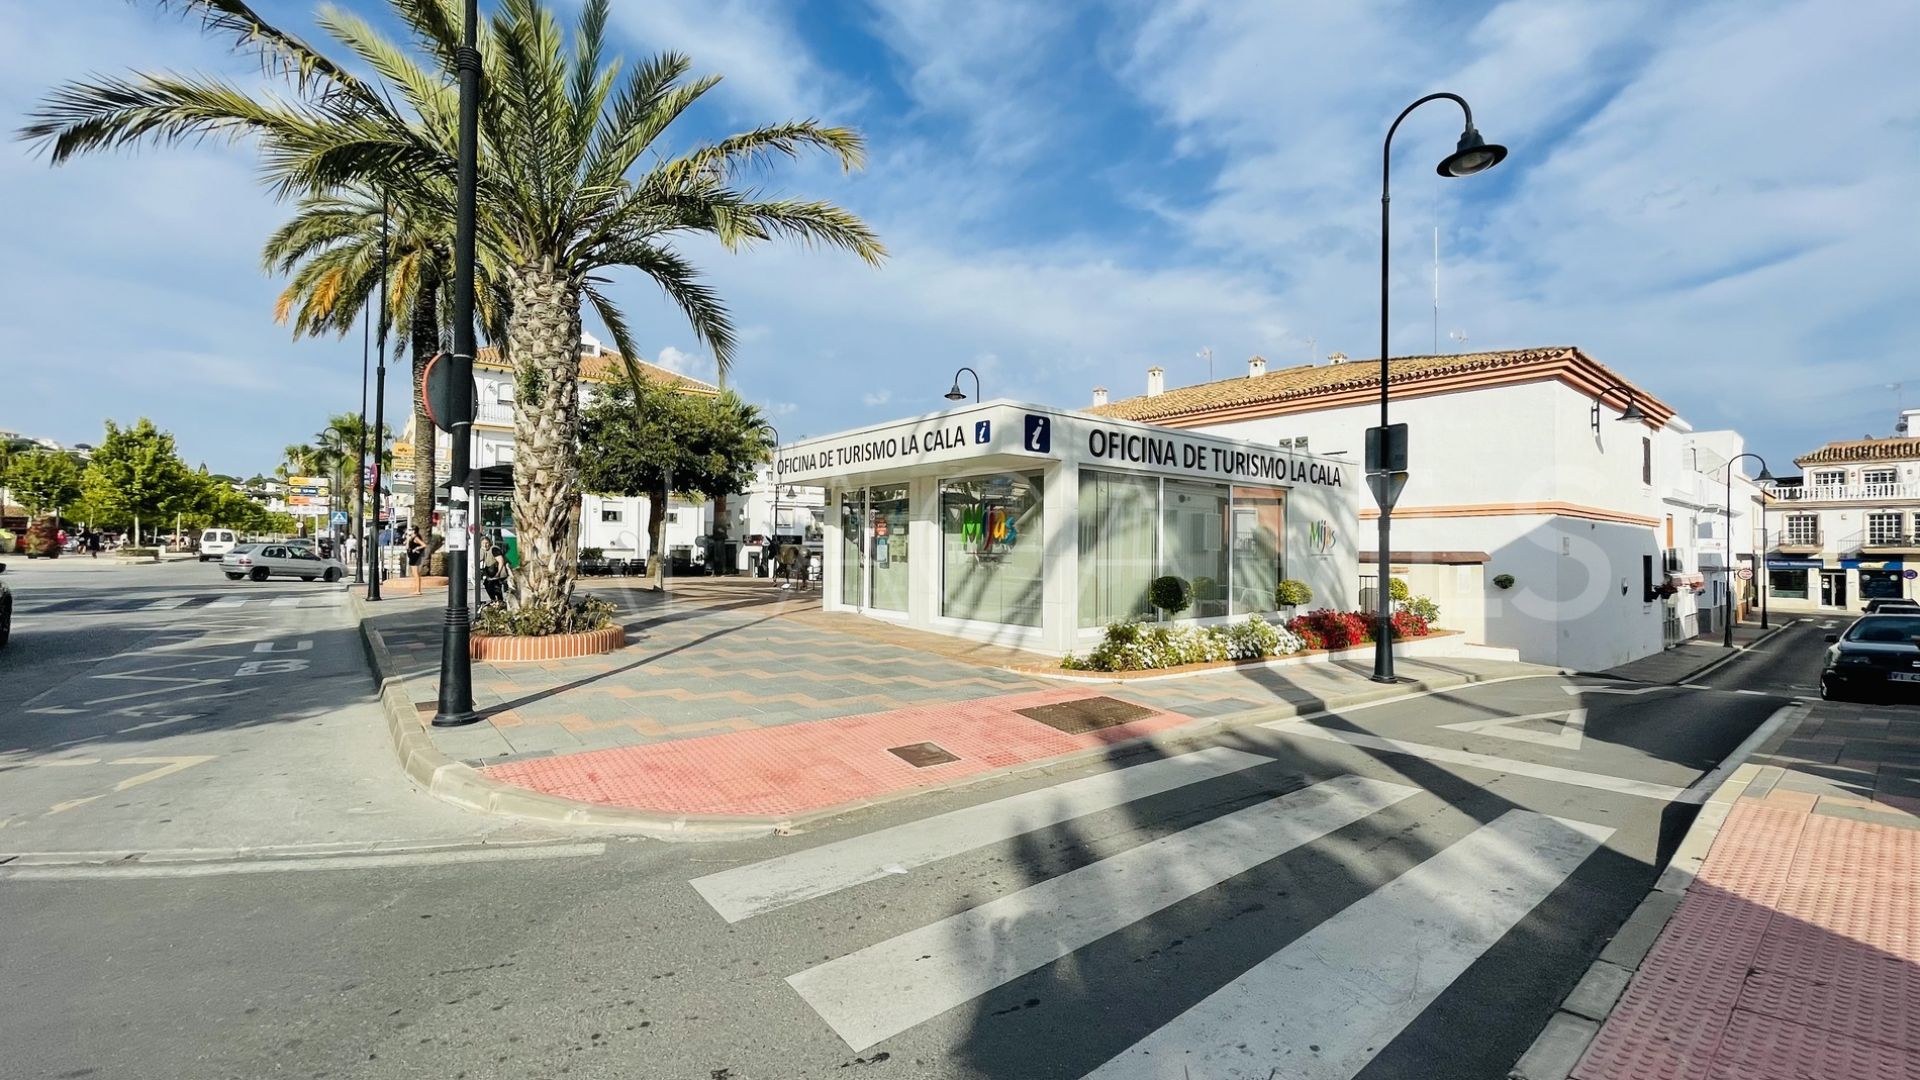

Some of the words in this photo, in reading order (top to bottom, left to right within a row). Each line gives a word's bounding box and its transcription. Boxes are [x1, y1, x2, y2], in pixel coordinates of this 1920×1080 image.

[776, 454, 817, 475] OFICINA
[819, 450, 834, 468] DE
[836, 439, 897, 466] TURISMO
[901, 433, 919, 455] LA
[923, 426, 965, 452] CALA
[1089, 428, 1177, 467] OFICINA
[1183, 443, 1207, 471] DE
[1212, 448, 1287, 480] TURISMO
[1290, 460, 1307, 483] LA
[1309, 463, 1341, 488] CALA
[961, 504, 1017, 550] Mijas
[1309, 519, 1337, 553] Mijas
